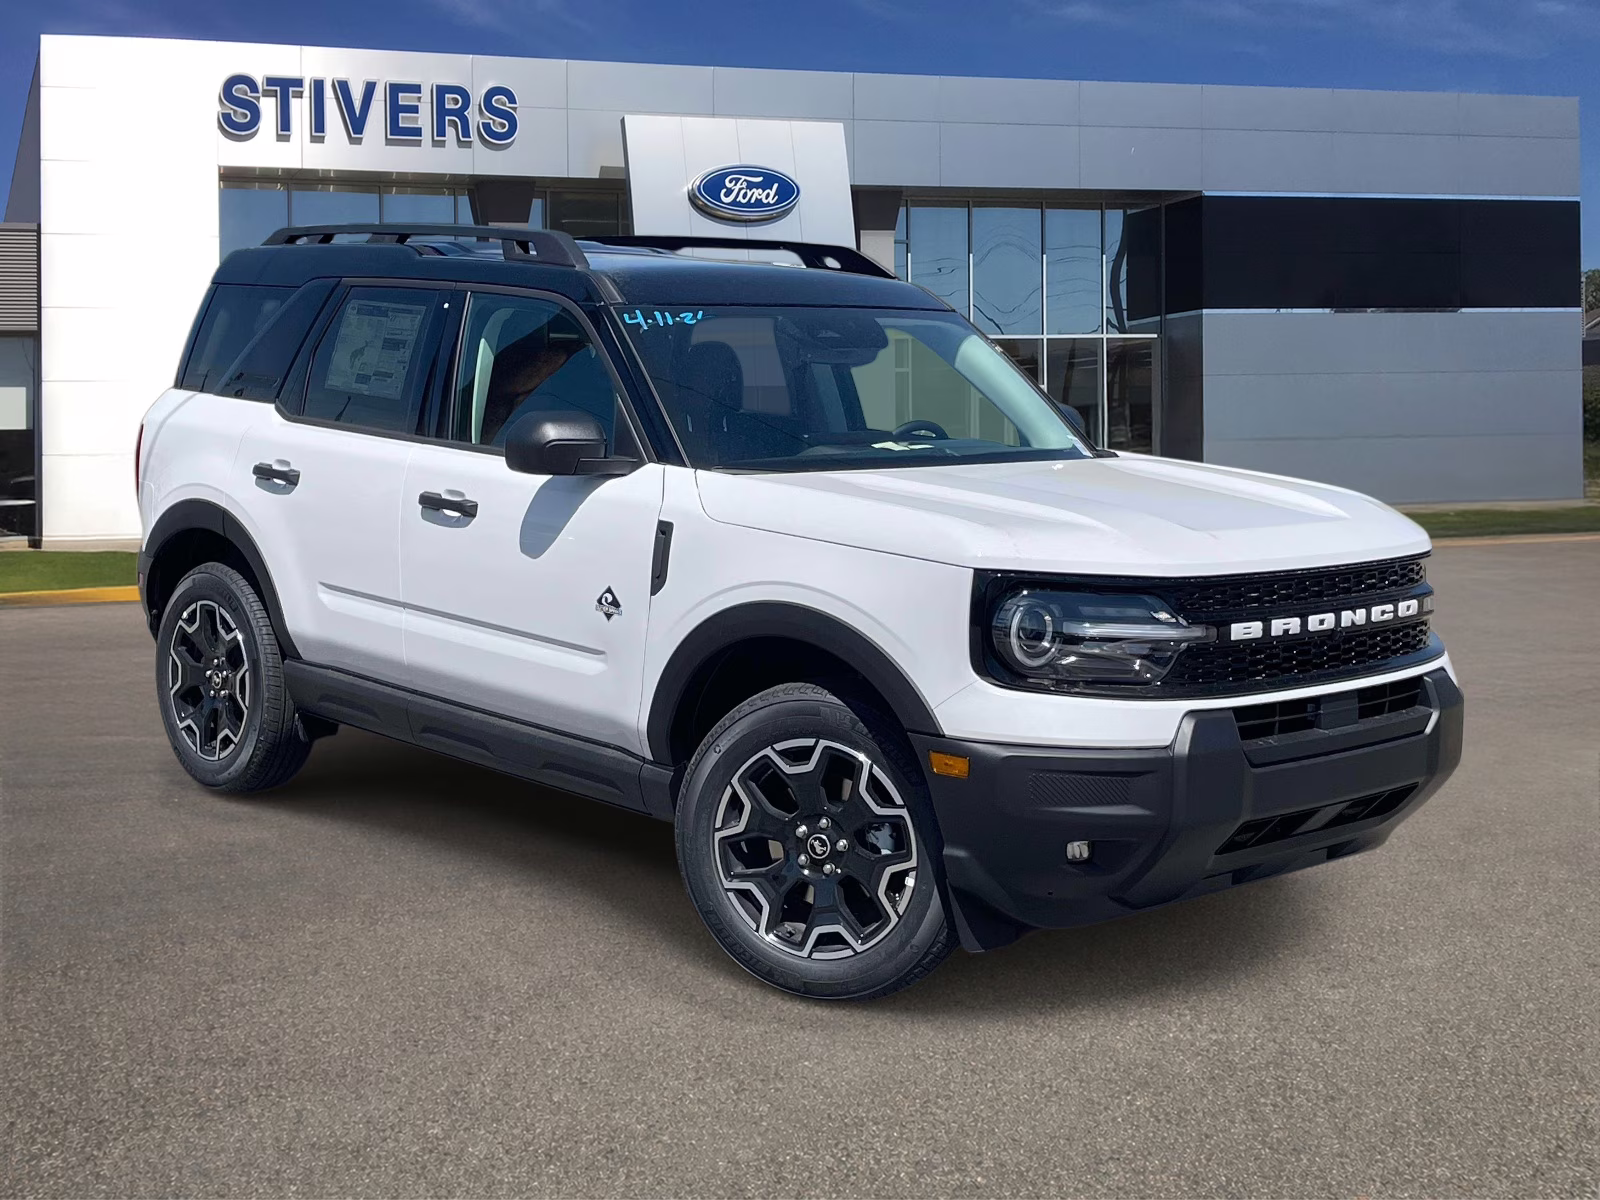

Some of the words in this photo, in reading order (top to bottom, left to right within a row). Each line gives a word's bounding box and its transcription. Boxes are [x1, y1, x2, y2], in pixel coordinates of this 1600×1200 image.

[218, 73, 519, 151] STIVERS
[720, 174, 779, 204] Ford
[1230, 599, 1418, 641] BRONCO
